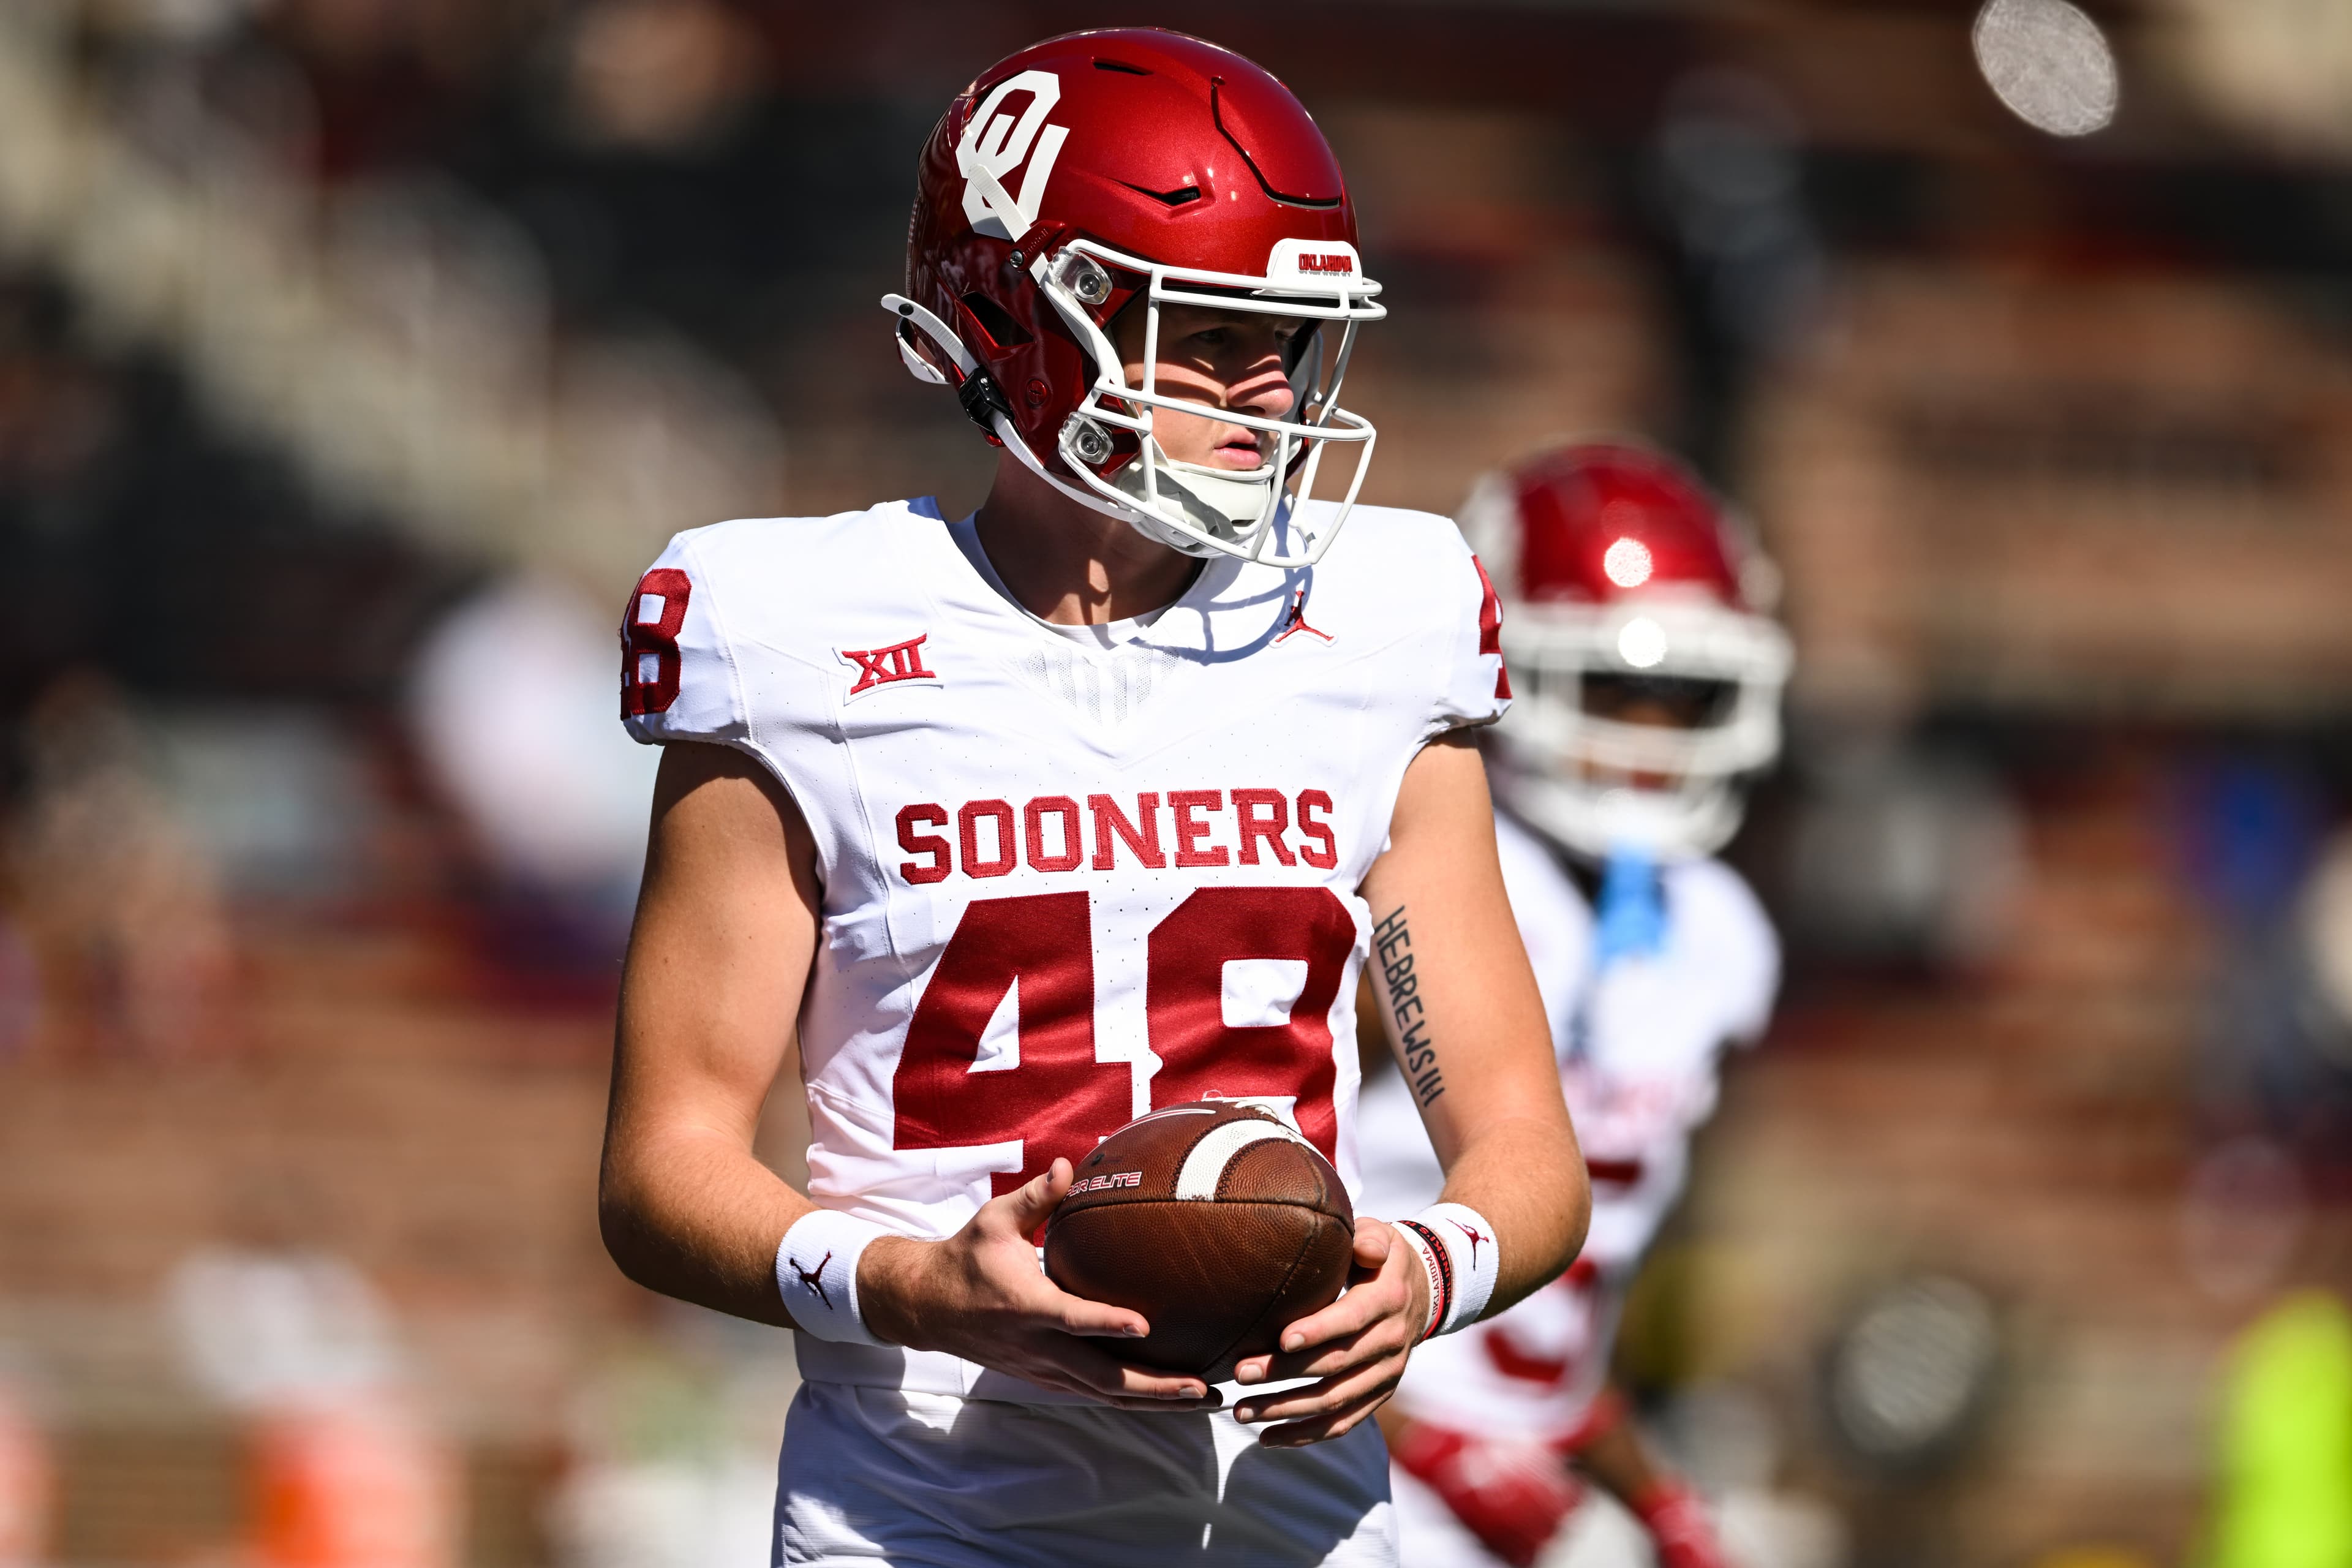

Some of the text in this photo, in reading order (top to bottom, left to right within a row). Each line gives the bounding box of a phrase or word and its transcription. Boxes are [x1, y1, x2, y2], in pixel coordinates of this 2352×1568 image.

[620, 568, 692, 720] 8
[841, 633, 937, 696] XII
[895, 788, 1338, 884] SOONERS
[1374, 905, 1435, 1073] HEBREWS
[893, 886, 1357, 1247] 48
[1089, 1172, 1142, 1191] ELITE
[1422, 1246, 1439, 1316] OKLAHOMA
